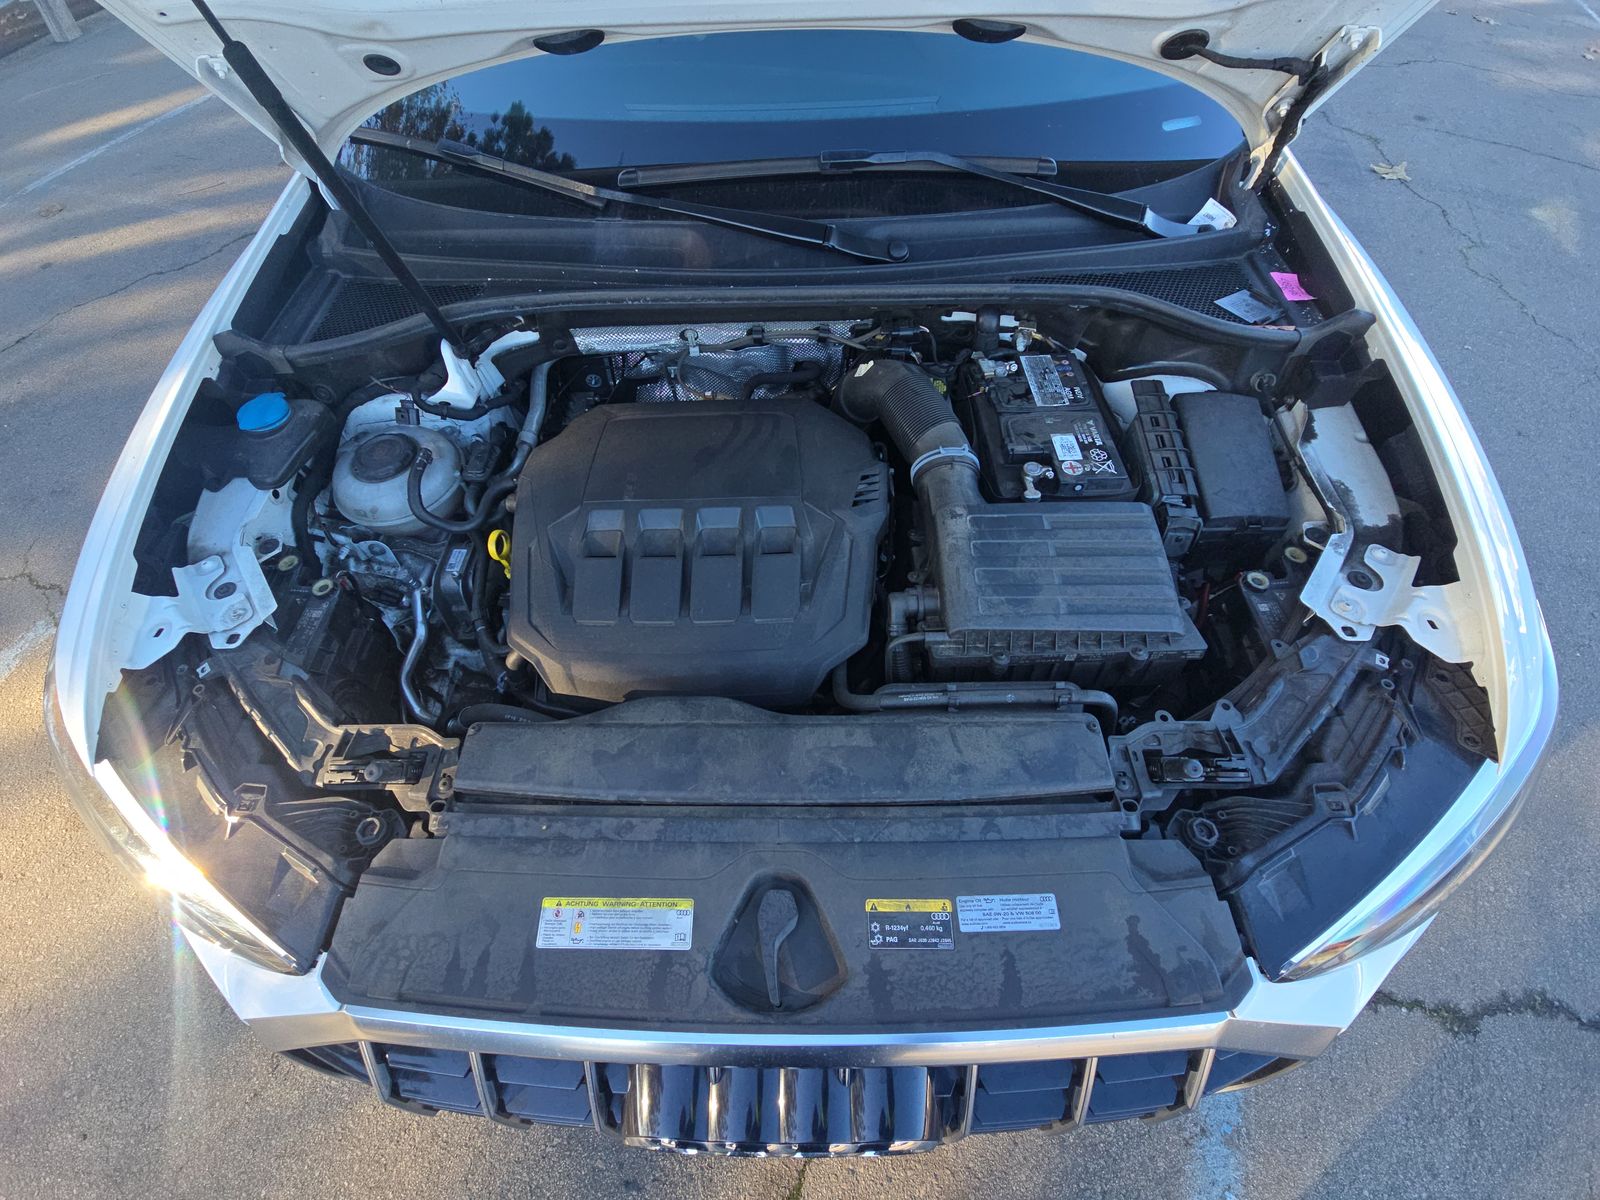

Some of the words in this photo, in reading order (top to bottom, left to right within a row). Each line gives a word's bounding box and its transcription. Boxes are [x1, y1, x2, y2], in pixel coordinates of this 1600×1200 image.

[1089, 425, 1103, 446] VARTA
[885, 924, 909, 932] R-1234yf
[936, 925, 943, 933] kg
